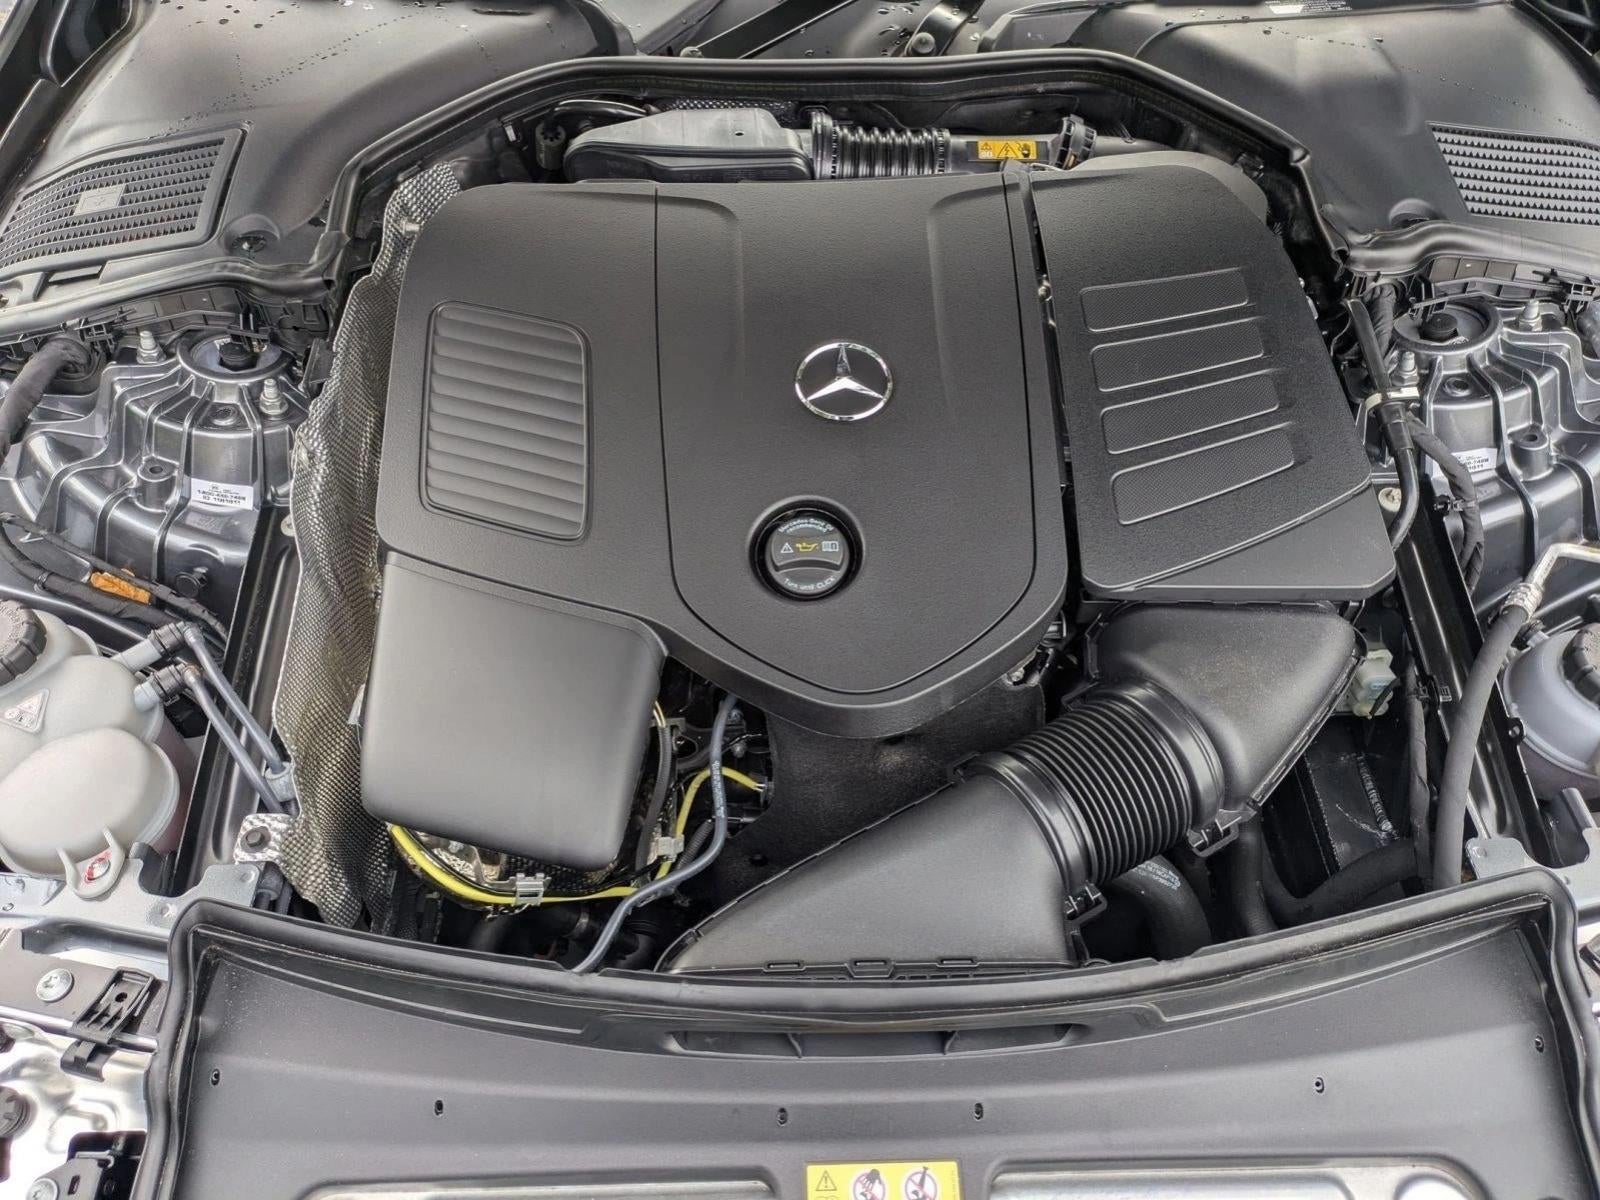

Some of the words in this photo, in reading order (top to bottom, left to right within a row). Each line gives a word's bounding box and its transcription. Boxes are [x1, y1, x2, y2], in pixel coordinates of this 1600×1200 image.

[783, 577, 798, 589] Turn
[799, 583, 815, 591] until
[816, 575, 837, 590] CLICK
